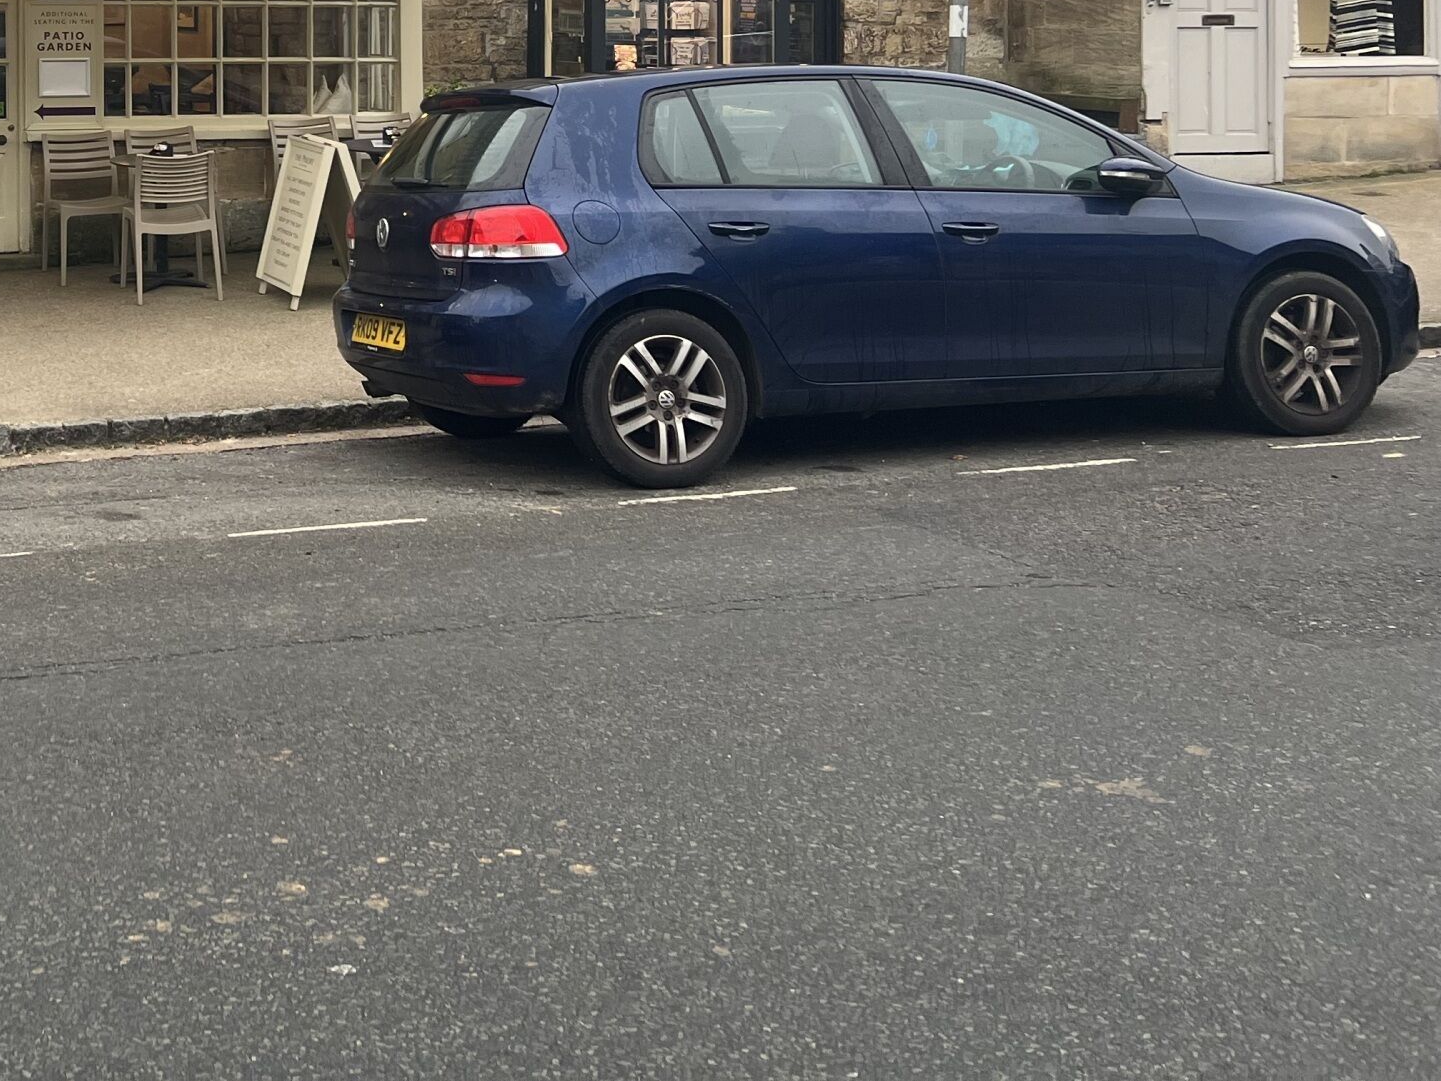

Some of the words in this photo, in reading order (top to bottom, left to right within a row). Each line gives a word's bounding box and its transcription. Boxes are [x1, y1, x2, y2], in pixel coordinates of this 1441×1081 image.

[44, 31, 85, 41] PATIO
[37, 42, 92, 52] GARDEN
[381, 320, 404, 345] VFZ
